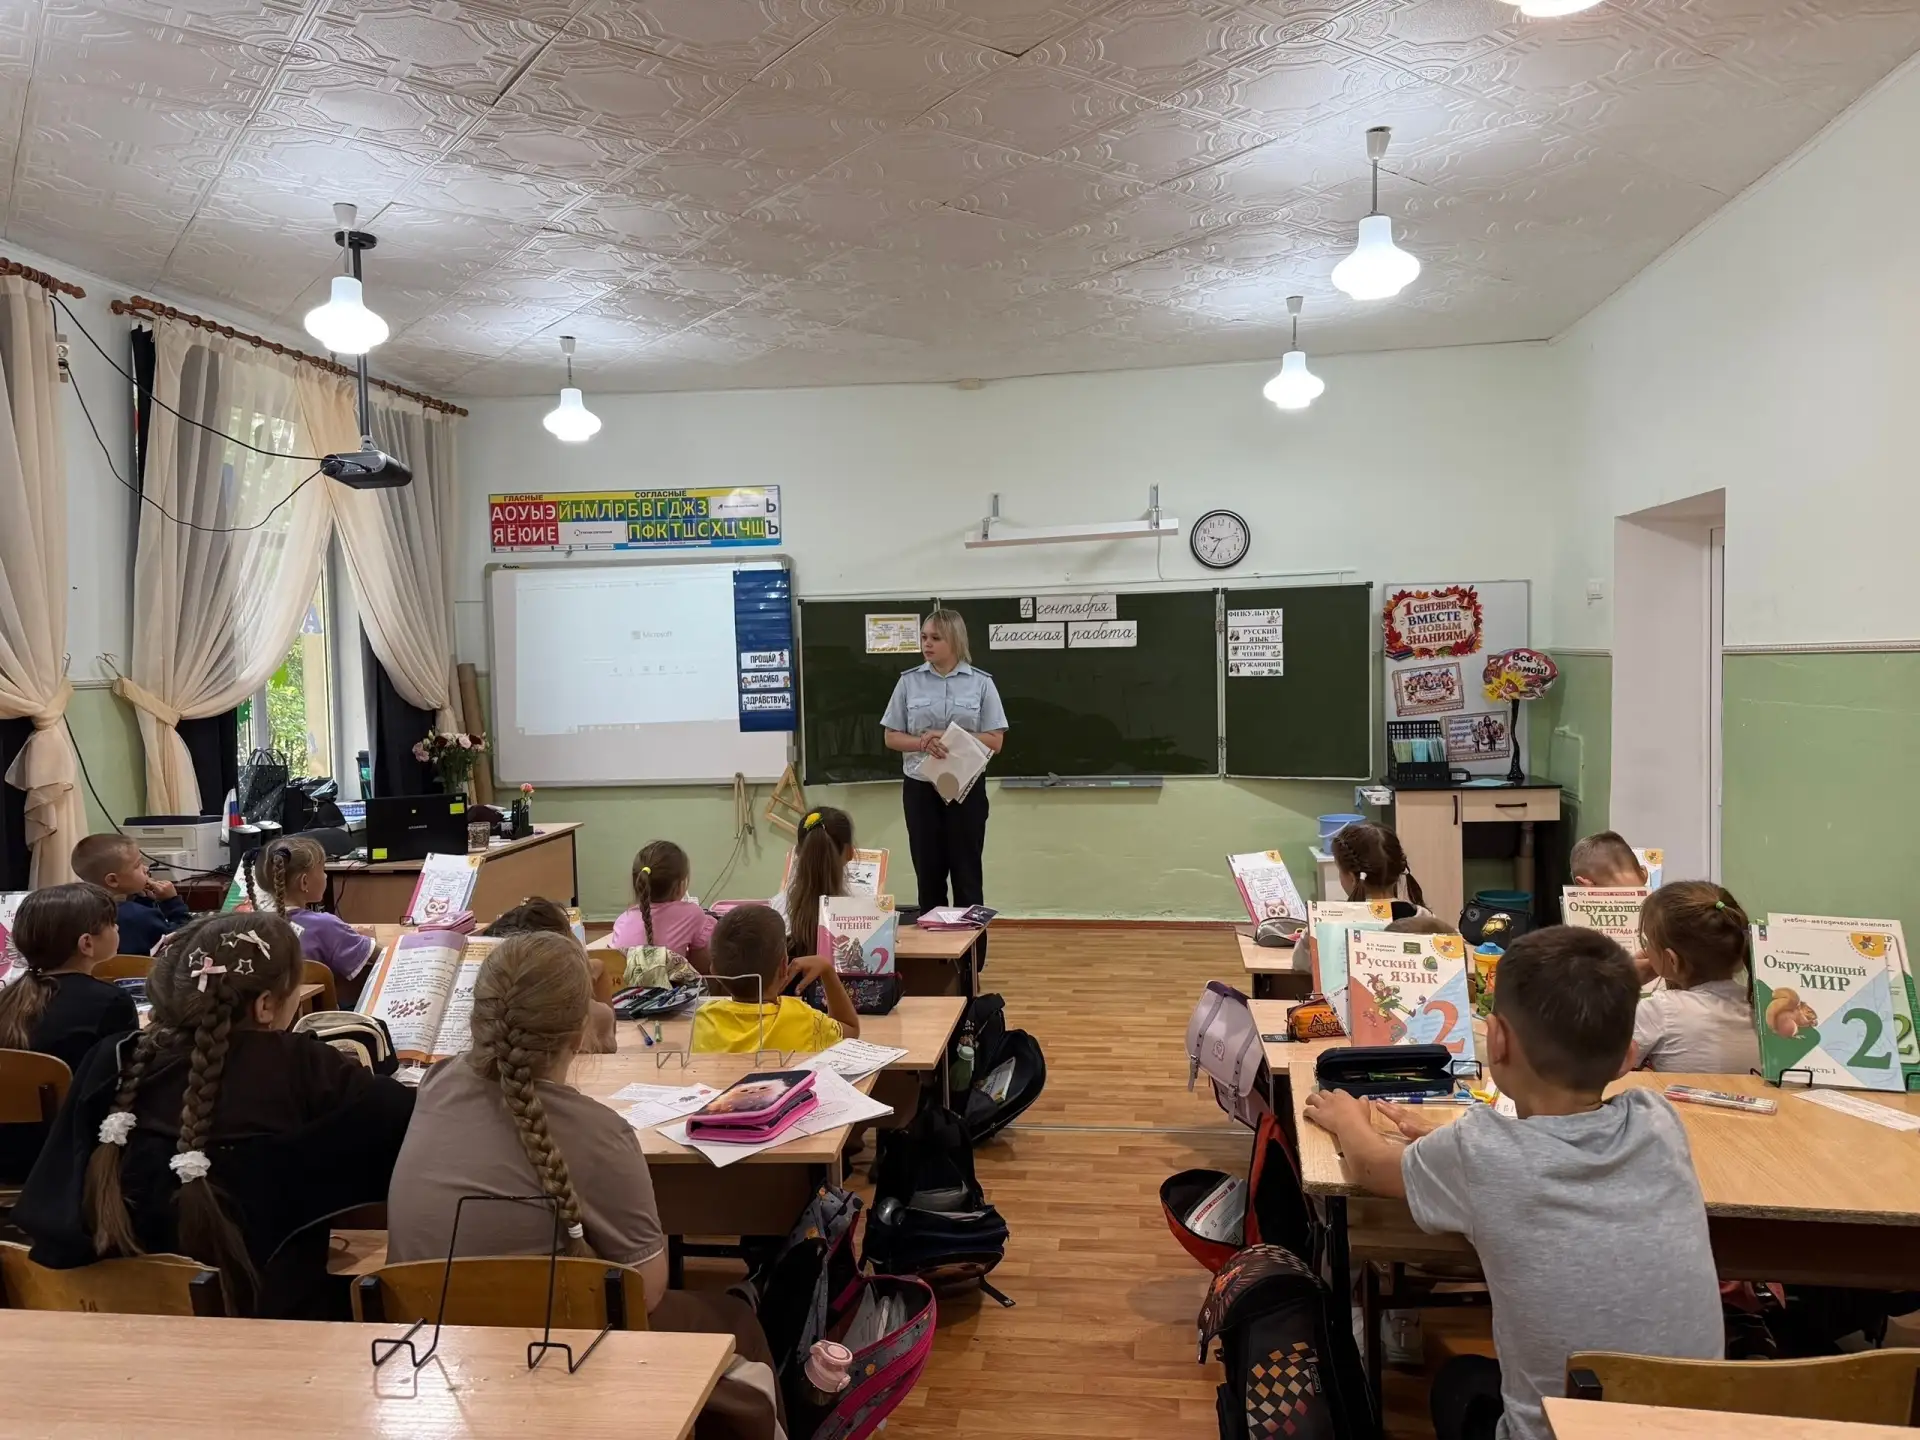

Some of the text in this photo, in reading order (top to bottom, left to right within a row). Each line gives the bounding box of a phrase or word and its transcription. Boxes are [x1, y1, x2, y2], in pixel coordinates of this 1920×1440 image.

[503, 494, 544, 502] ГЛАСНЫЕ
[634, 490, 687, 499] СОГЛАСНЫЕ
[1021, 594, 1113, 619] 4 сентября.
[1403, 600, 1413, 616] 1
[1408, 611, 1461, 626] ВМЕСТЕ
[990, 625, 1063, 642] Классная
[1408, 621, 1462, 635] К НОВЫМ
[1405, 629, 1467, 645] ЗНАНИЯМ!
[829, 913, 880, 923] Литературное
[836, 922, 872, 930] ЧТЕНИЕ
[1589, 914, 1628, 927] МИР
[1606, 928, 1633, 936] ТЕТРАДЬ
[1355, 950, 1418, 969] Русский
[1763, 954, 1867, 977] Окружающий
[1800, 973, 1851, 992] МИР
[1423, 999, 1466, 1054] 2
[1842, 1007, 1892, 1069] 2
